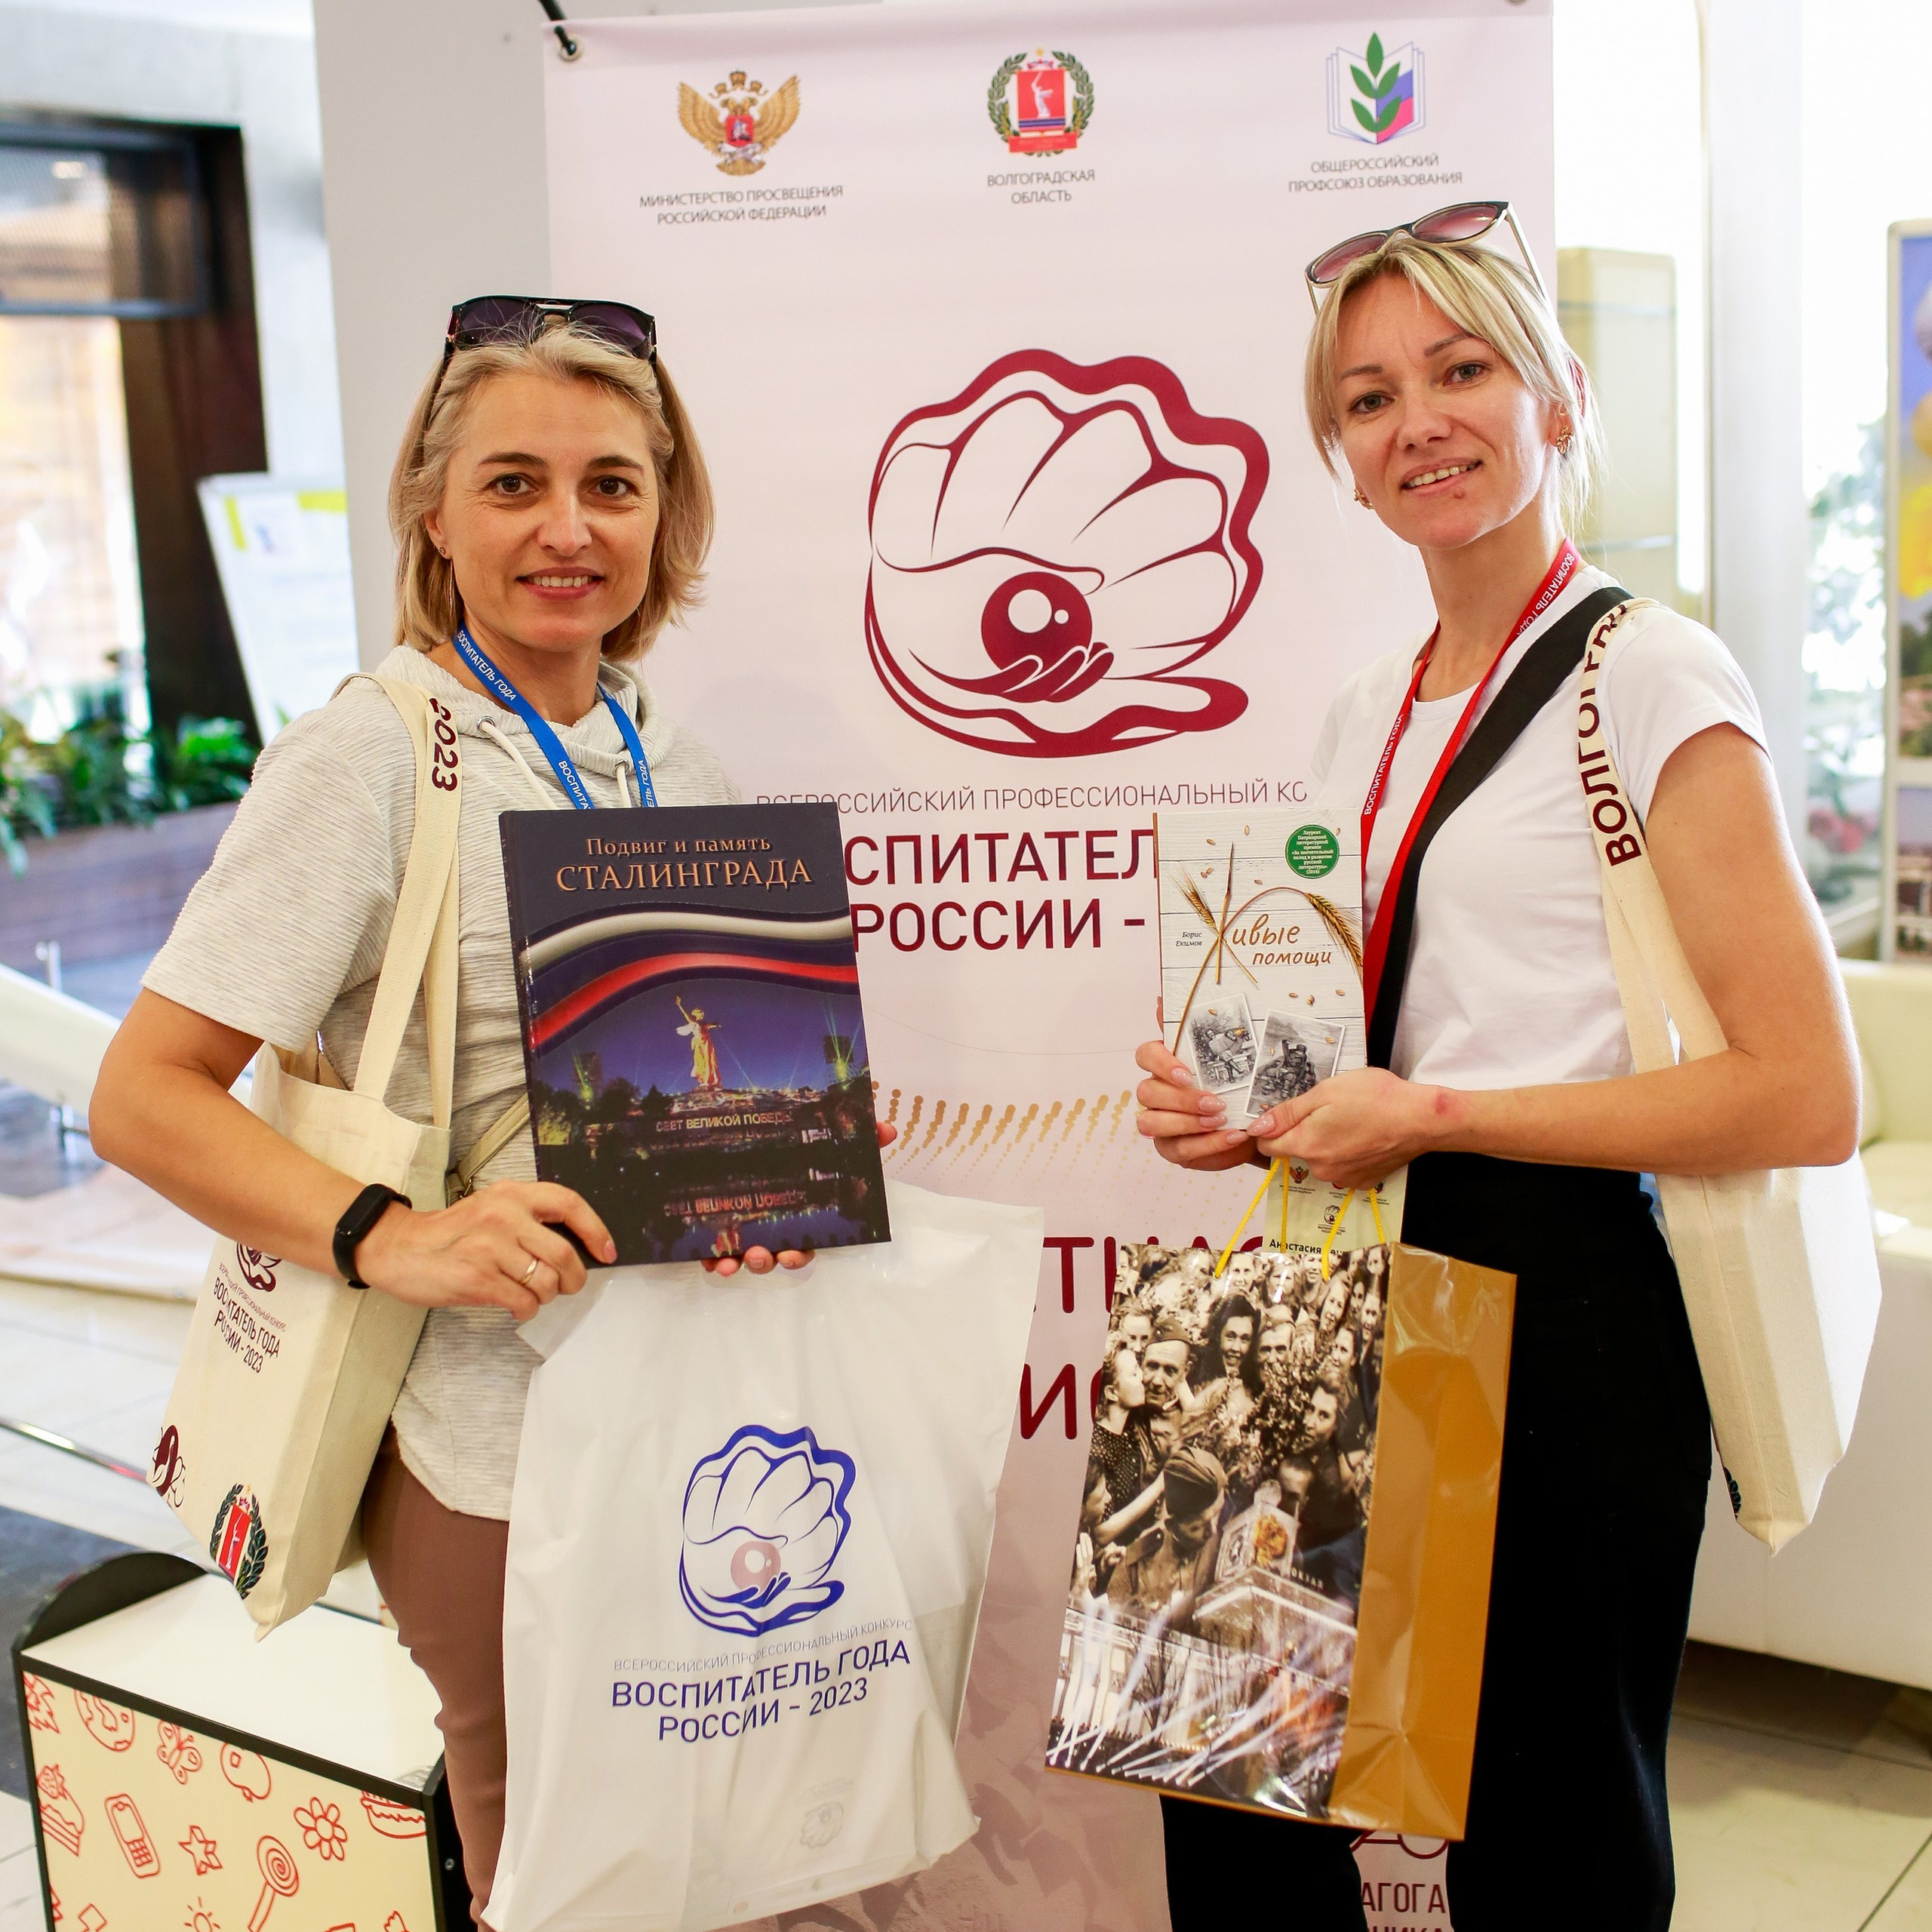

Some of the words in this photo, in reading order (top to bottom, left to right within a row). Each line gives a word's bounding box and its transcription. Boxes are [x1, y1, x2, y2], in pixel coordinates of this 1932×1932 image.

[1310, 152, 1439, 173] ОБЩЕРОССИЙСКИЙ
[986, 169, 1095, 186] ВОЛГОГРАДСКАЯ
[1287, 177, 1364, 192] ПРОФСОЮЗ
[1367, 171, 1463, 188] ОБРАЗОВАНИЯ
[639, 190, 744, 208] МИНИСТЕРСТВО
[746, 185, 844, 202] ПРОСВЕЩЕНИЯ
[1011, 189, 1072, 204] ОБЛАСТЬ
[657, 207, 745, 225] РОССИЙСКОЙ
[748, 205, 827, 221] ФЕДЕРАЦИИ
[494, 678, 516, 700] ГОДА
[428, 697, 460, 792] 2023
[558, 760, 592, 810] ВОСПИТА
[638, 759, 650, 786] ГОДА
[984, 777, 1268, 811] ПРОФЕССИОНАЛЬНЫЙ
[586, 838, 666, 857] Подвиг
[674, 840, 688, 853] и
[694, 837, 771, 853] память
[844, 829, 1158, 886] СПИТАТЕЛ
[556, 858, 813, 891] СТАЛИНГРАДА
[851, 898, 1101, 952] РОССИИ
[1182, 931, 1202, 940] Борис
[1252, 950, 1332, 967] помощи
[685, 1115, 741, 1130] ВЕЛИКОЙ
[1269, 1238, 1322, 1254] Анстасия
[214, 1276, 257, 1340] ВОСИТАТЕЛЬ
[256, 1326, 281, 1358] ГОДА
[243, 1344, 263, 1374] 2023
[613, 1652, 730, 1673] ВСЕРОССИЙСКИЙ
[860, 1617, 912, 1636] КОНКУРС
[612, 1660, 831, 1709] ВОСПИТАТЕЛЬ
[838, 1639, 911, 1676] ГОДА
[659, 1699, 780, 1743] РОССИИ
[809, 1676, 867, 1717] 2023
[1361, 1881, 1446, 1913] АГОГА
